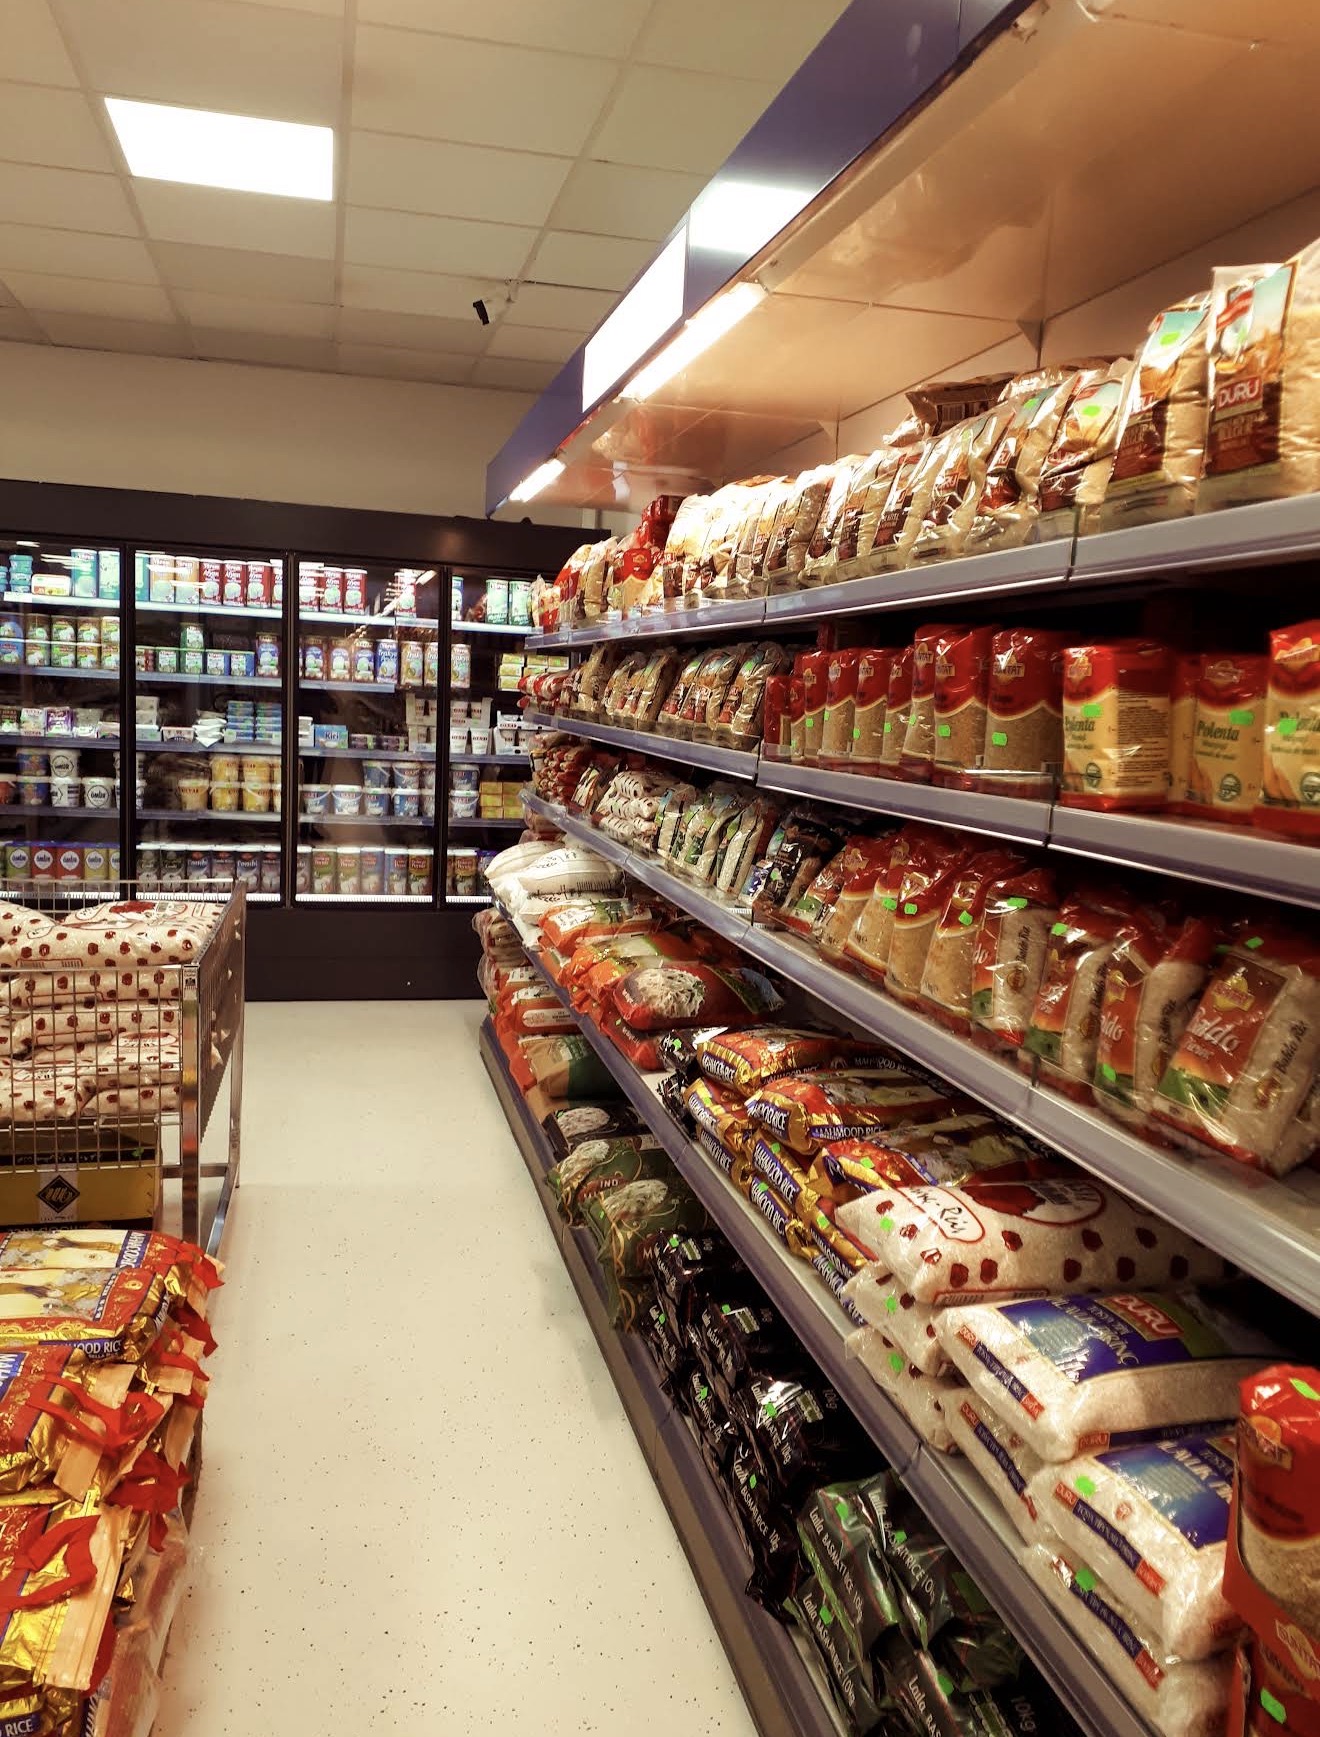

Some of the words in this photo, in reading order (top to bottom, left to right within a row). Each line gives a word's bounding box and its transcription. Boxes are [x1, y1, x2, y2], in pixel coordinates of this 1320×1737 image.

[1219, 380, 1259, 407] DURU
[325, 731, 340, 740] Kiri
[1197, 720, 1240, 740] Polenta
[772, 1110, 788, 1131] RICE
[754, 1143, 783, 1187] MAHMOOD
[779, 1177, 797, 1205] RICE
[1112, 1295, 1180, 1334] DURU
[960, 1326, 977, 1346] DURU
[961, 1404, 979, 1424] DURU
[1081, 1434, 1108, 1448] DURU
[1057, 1485, 1077, 1505] DURU
[755, 1515, 769, 1536] RICE
[810, 1505, 826, 1536] Laila
[821, 1532, 847, 1576] BASMATI
[906, 1555, 926, 1581] RICE
[803, 1592, 818, 1621] Laila
[816, 1619, 835, 1655] BASMATI
[832, 1652, 845, 1679] RICE
[843, 1674, 857, 1708] 10kg
[908, 1675, 927, 1715] Laila
[1011, 1695, 1037, 1733] 10kg
[5, 1719, 34, 1737] RICE
